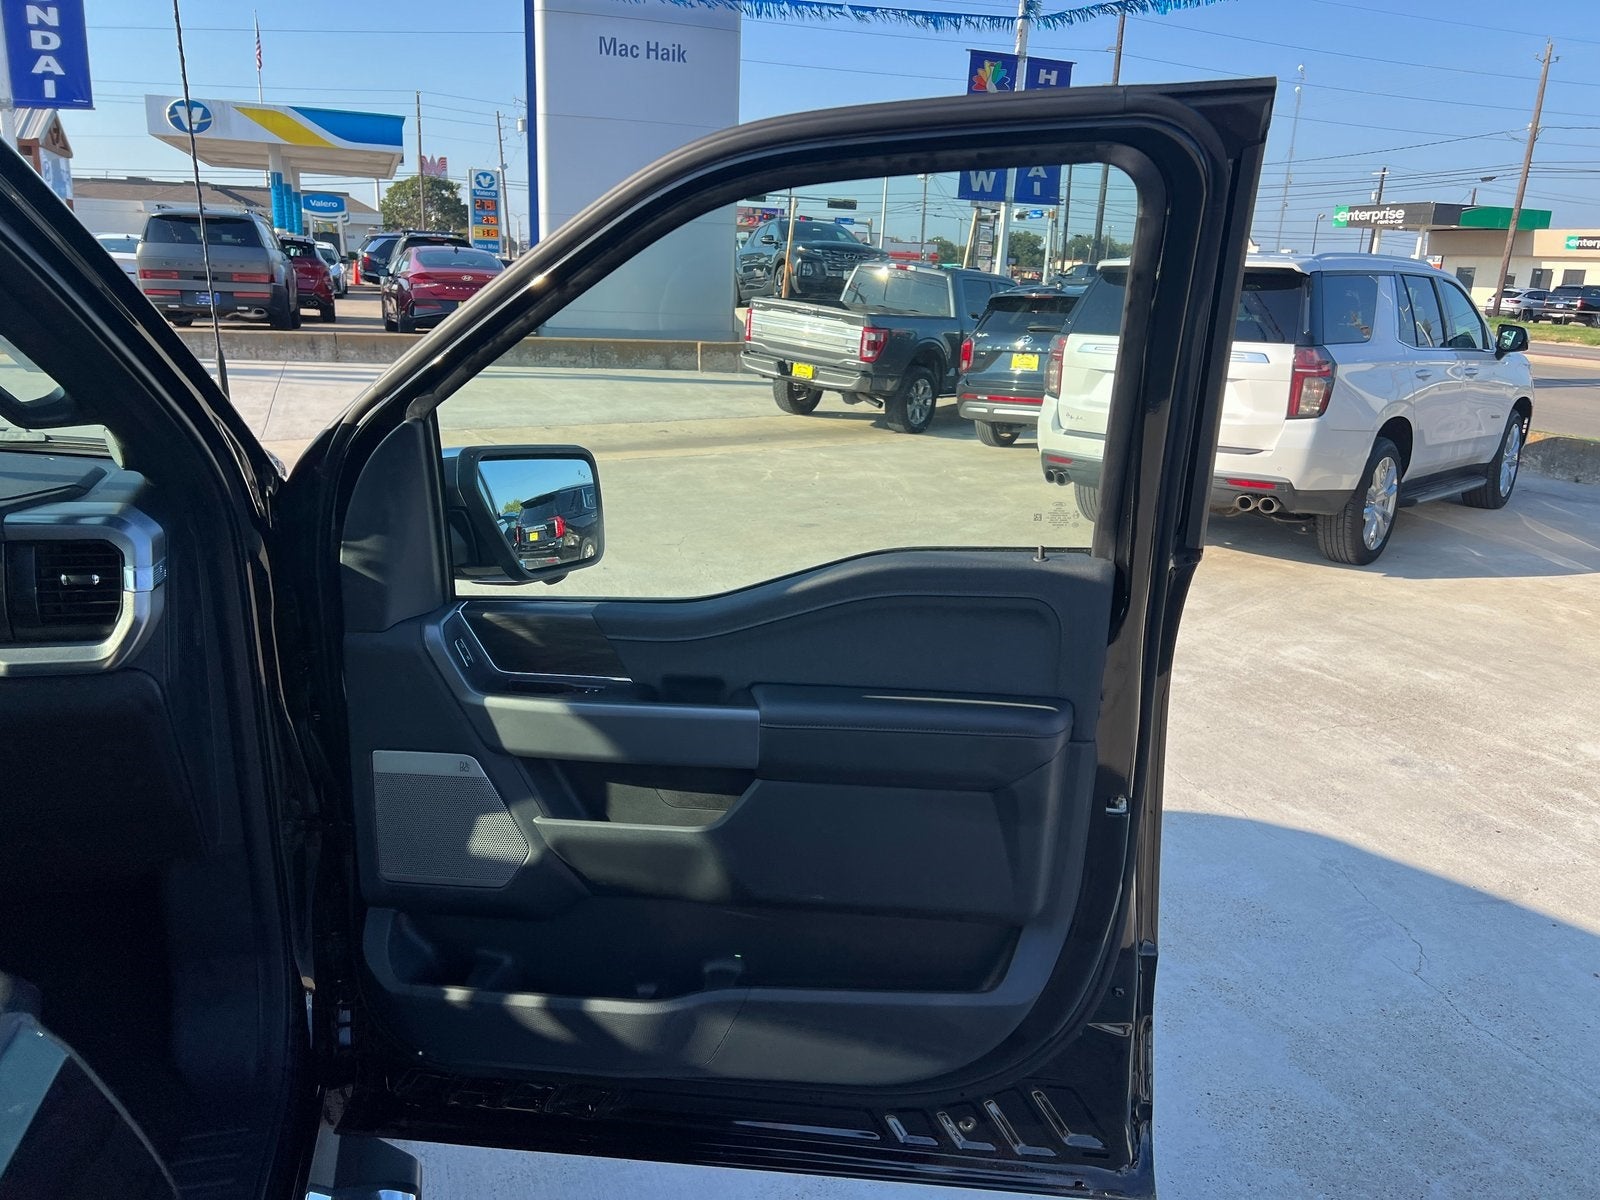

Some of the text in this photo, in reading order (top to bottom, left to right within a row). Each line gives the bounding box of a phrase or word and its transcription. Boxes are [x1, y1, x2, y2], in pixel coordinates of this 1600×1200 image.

[26, 0, 66, 98] NDAI
[599, 36, 688, 63] Mac Haik
[475, 189, 496, 197] Valero
[309, 199, 338, 208] Valero
[1334, 206, 1405, 223] enterprise
